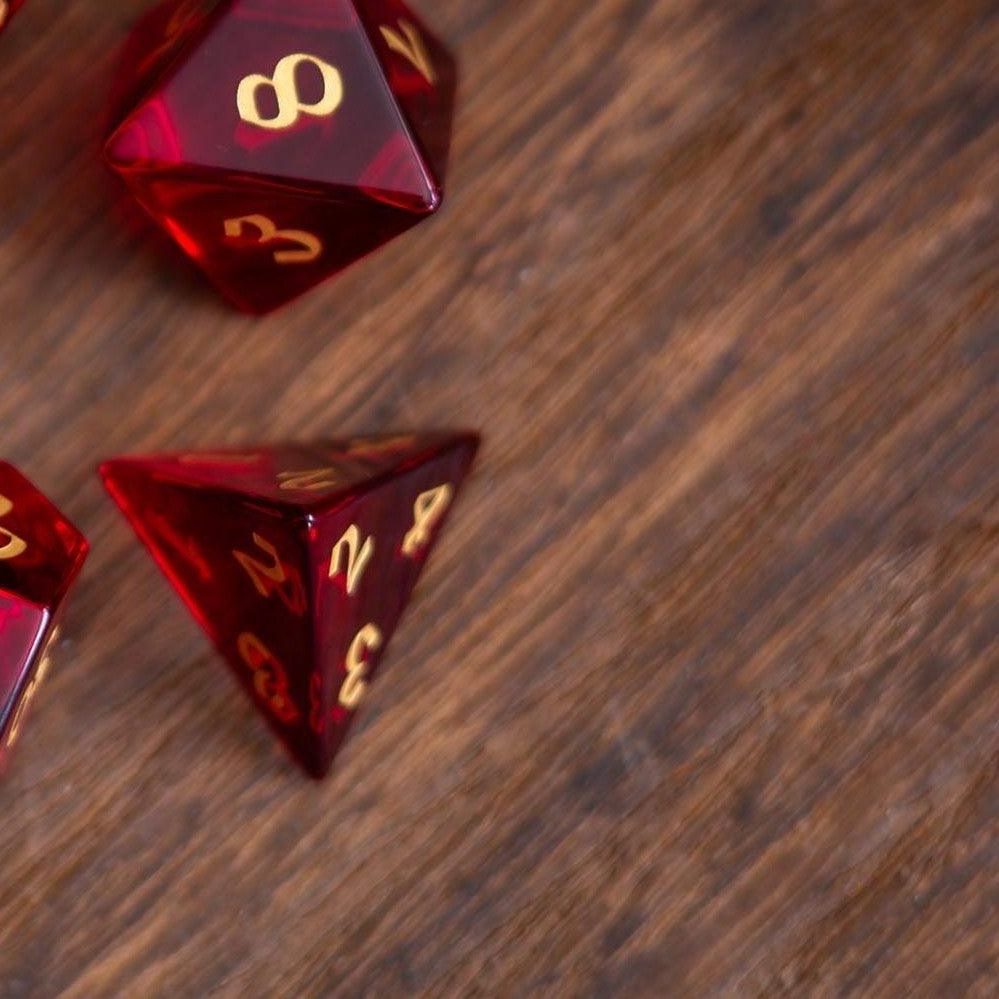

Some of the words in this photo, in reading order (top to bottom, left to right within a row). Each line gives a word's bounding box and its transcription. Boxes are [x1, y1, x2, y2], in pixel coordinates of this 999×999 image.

[236, 53, 344, 129] 8
[223, 213, 323, 264] 3
[328, 524, 376, 596] 2
[338, 622, 382, 711] 3
